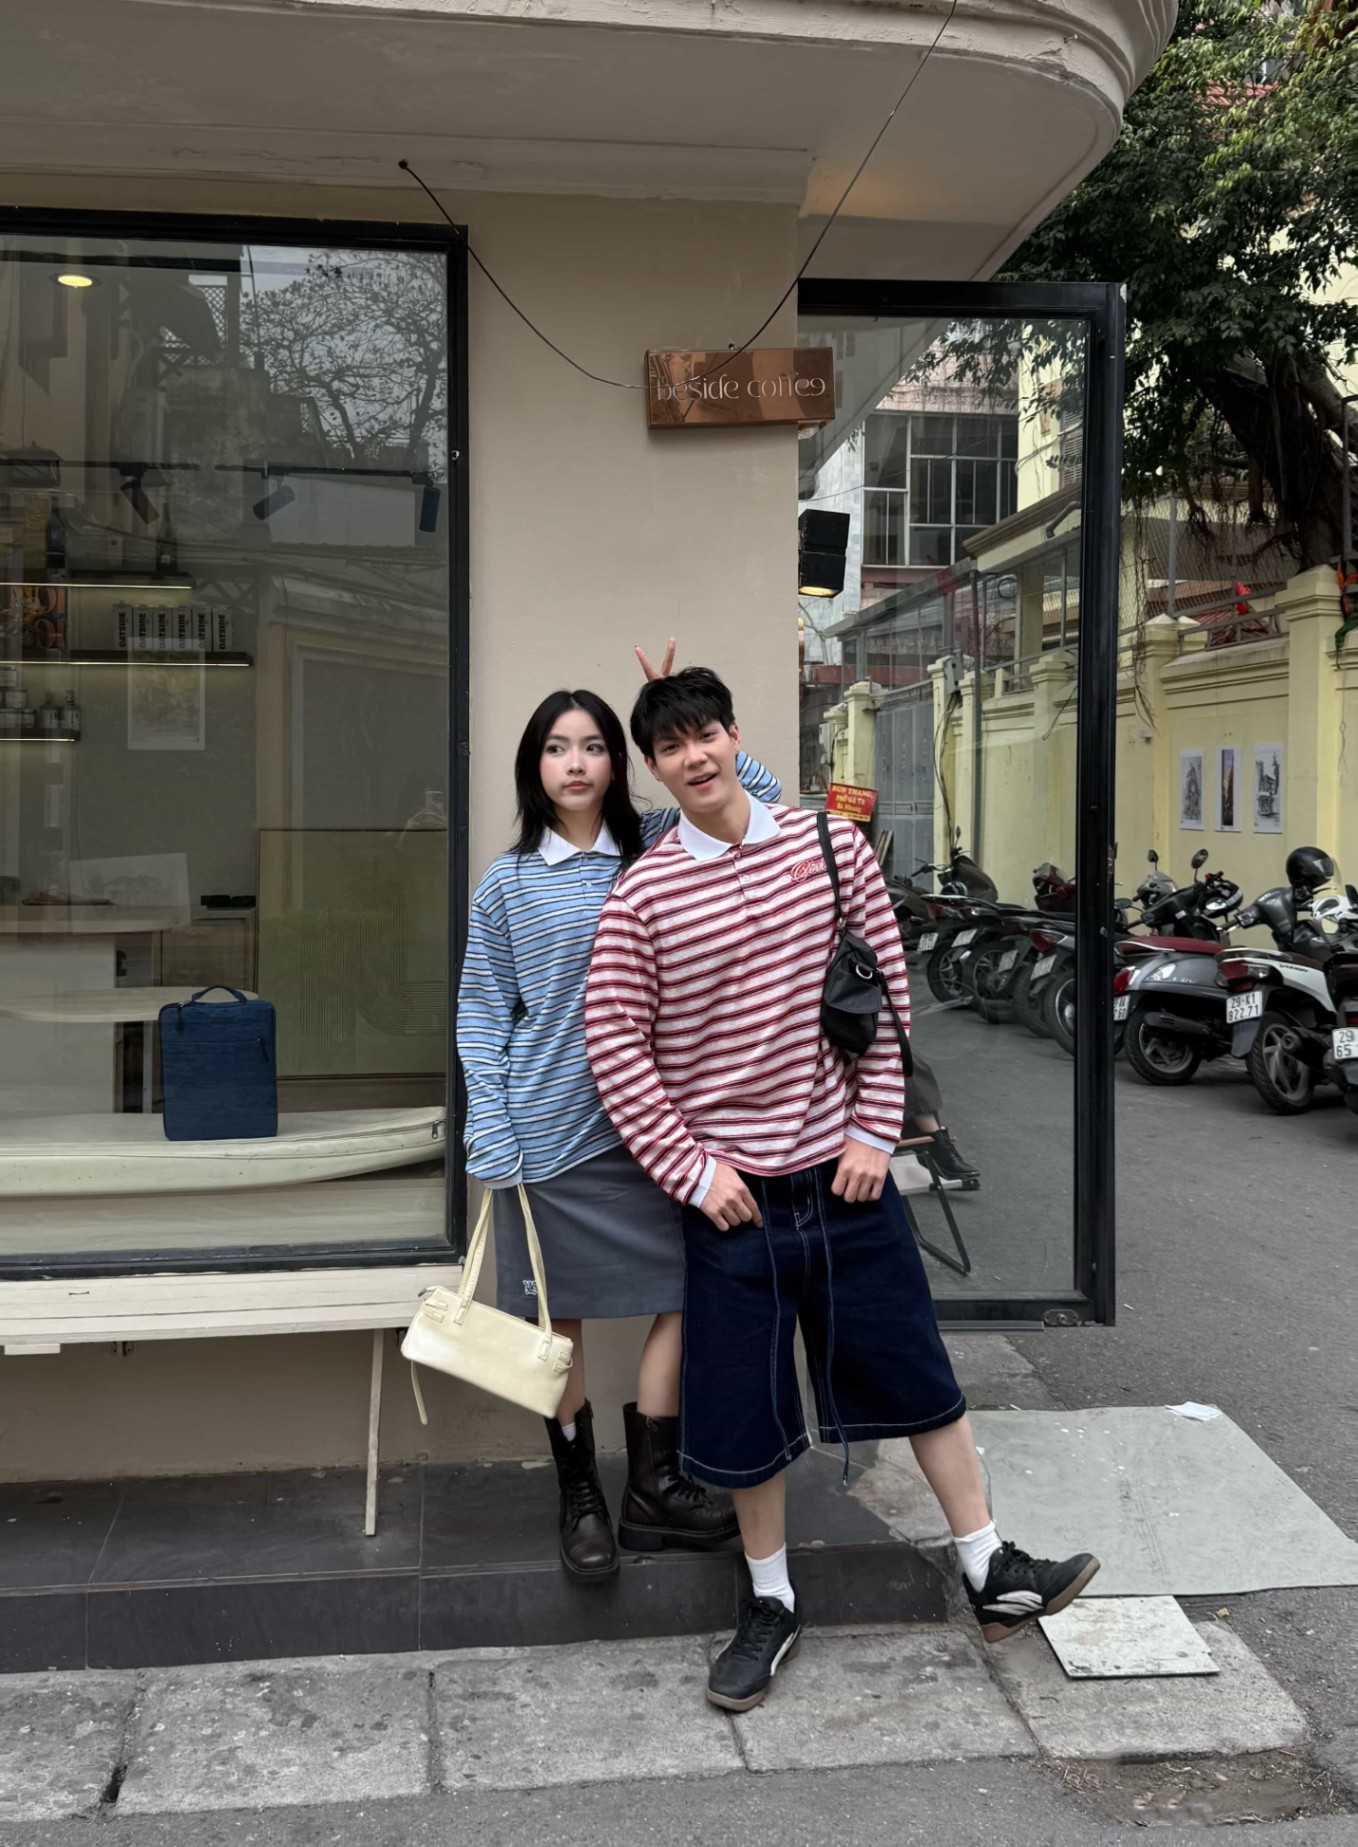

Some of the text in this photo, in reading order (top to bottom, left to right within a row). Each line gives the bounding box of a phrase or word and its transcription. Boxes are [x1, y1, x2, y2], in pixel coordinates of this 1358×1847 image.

[657, 374, 739, 401] beside
[118, 612, 126, 647] OATSIDE
[158, 613, 166, 648] OATSIDE
[178, 614, 186, 649] OATSIDE
[218, 614, 226, 650] OATSIDE
[1228, 1004, 1258, 1021] 822.71
[1231, 993, 1255, 1008] 29-K1
[1336, 1043, 1358, 1058] 65
